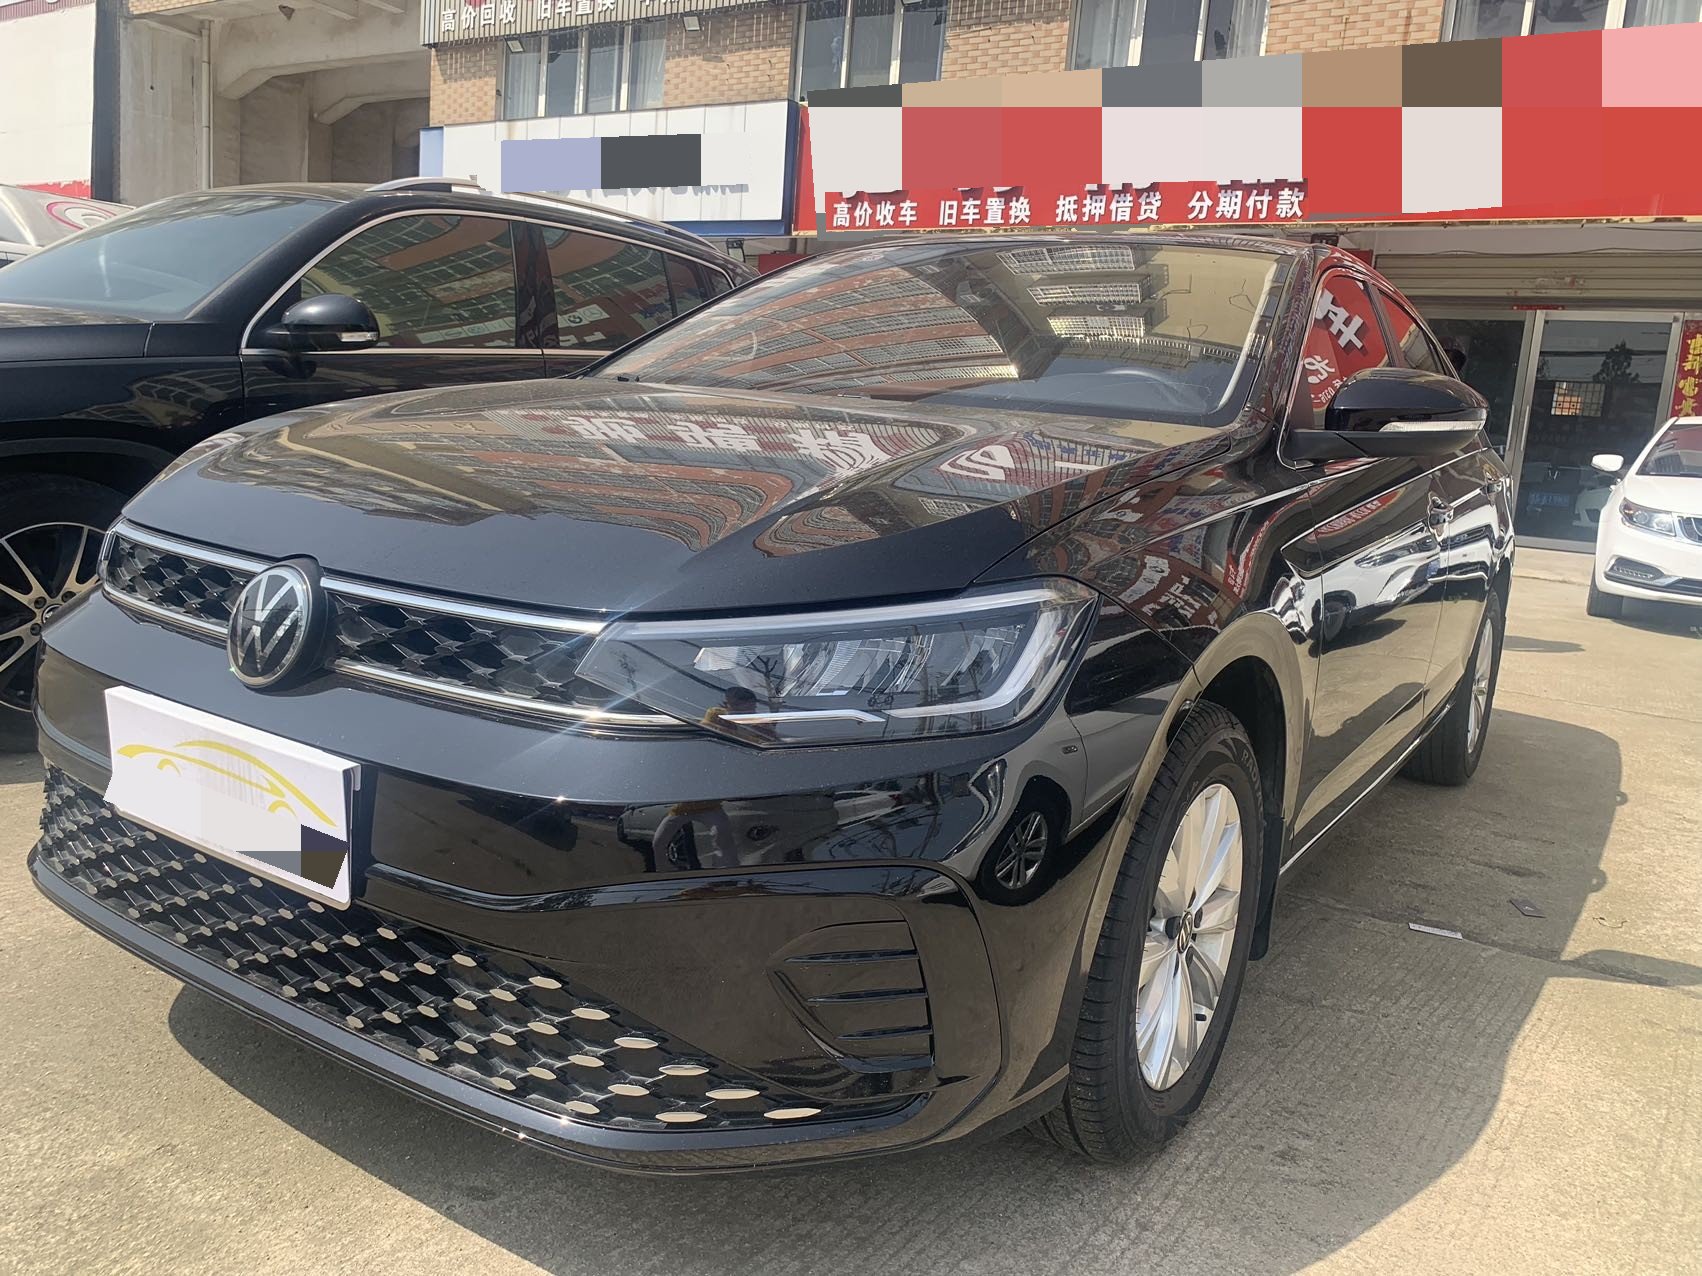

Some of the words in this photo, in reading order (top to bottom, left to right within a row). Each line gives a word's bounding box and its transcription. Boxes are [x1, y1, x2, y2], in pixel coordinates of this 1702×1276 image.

[441, 0, 516, 33] 高价回收
[833, 199, 918, 227] 高价收车
[939, 197, 1031, 226] 旧车置换
[1056, 191, 1162, 222] 抵押借贷
[1187, 187, 1305, 219] 分期付款
